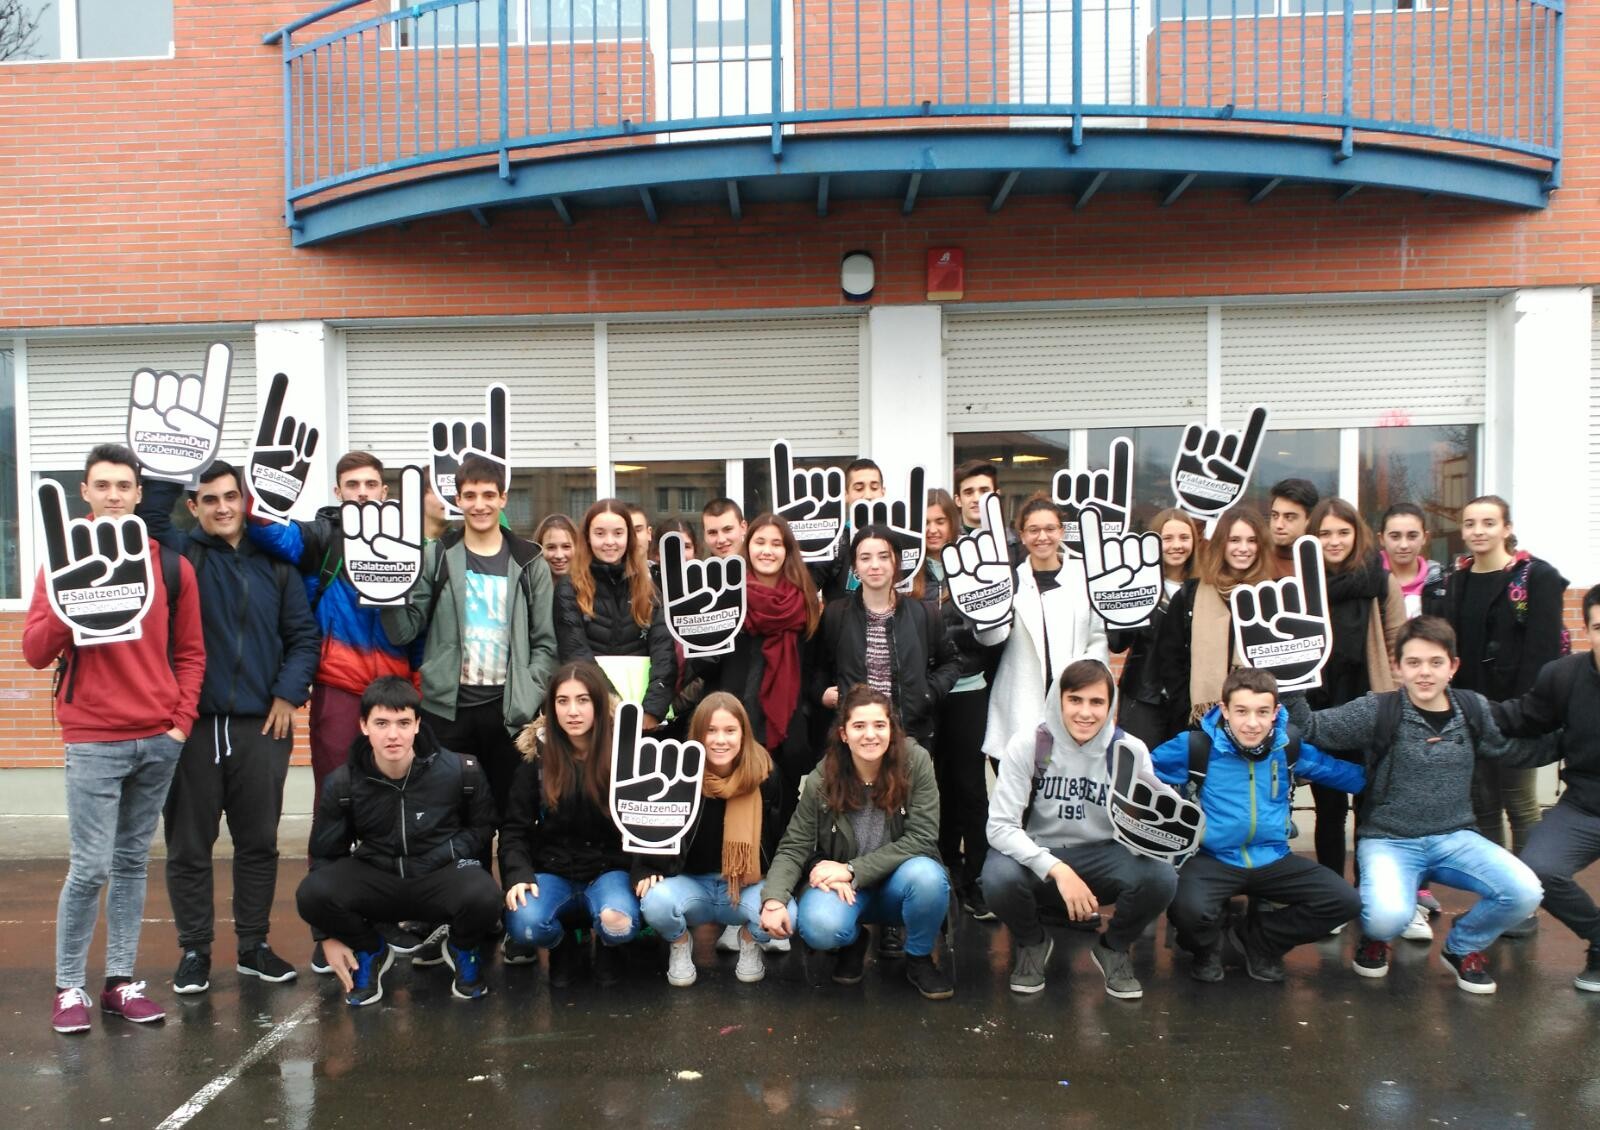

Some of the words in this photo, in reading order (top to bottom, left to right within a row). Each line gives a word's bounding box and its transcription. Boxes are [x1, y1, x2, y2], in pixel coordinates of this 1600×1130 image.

[136, 432, 209, 449] #SalatzenDut
[139, 444, 203, 460] #YoDenuncio
[789, 520, 837, 530] SalatzenDut
[350, 561, 415, 571] #SalatzenDut
[355, 573, 411, 582] #YoDenuncio
[62, 586, 143, 601] #SalatzenDut
[1095, 585, 1157, 600] #SalatzenDut
[1100, 598, 1154, 610] #YoDenuncio
[676, 609, 738, 624] #SalatzenDut
[1250, 638, 1323, 655] #SalatzenDut
[1035, 776, 1111, 806] PULL&BEA
[620, 802, 689, 813] #SalatzenDut
